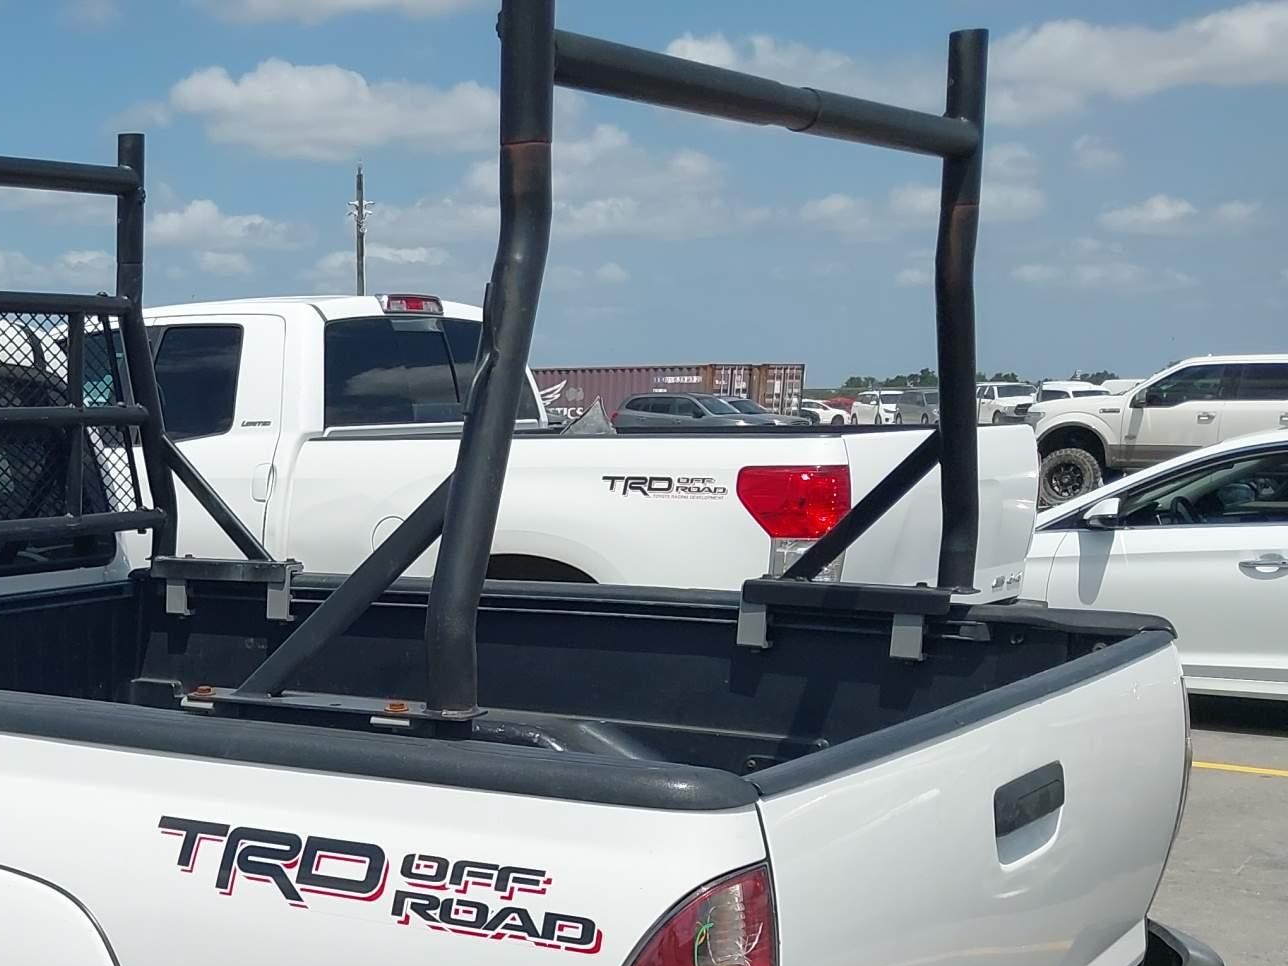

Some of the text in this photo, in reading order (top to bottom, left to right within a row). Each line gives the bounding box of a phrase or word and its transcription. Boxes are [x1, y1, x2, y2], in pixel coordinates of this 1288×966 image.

[602, 476, 674, 497] TRD
[676, 486, 728, 494] ROAD
[677, 477, 716, 485] OFF
[158, 815, 389, 908] TRD
[400, 854, 553, 899] OFF
[391, 890, 602, 954] ROAD
